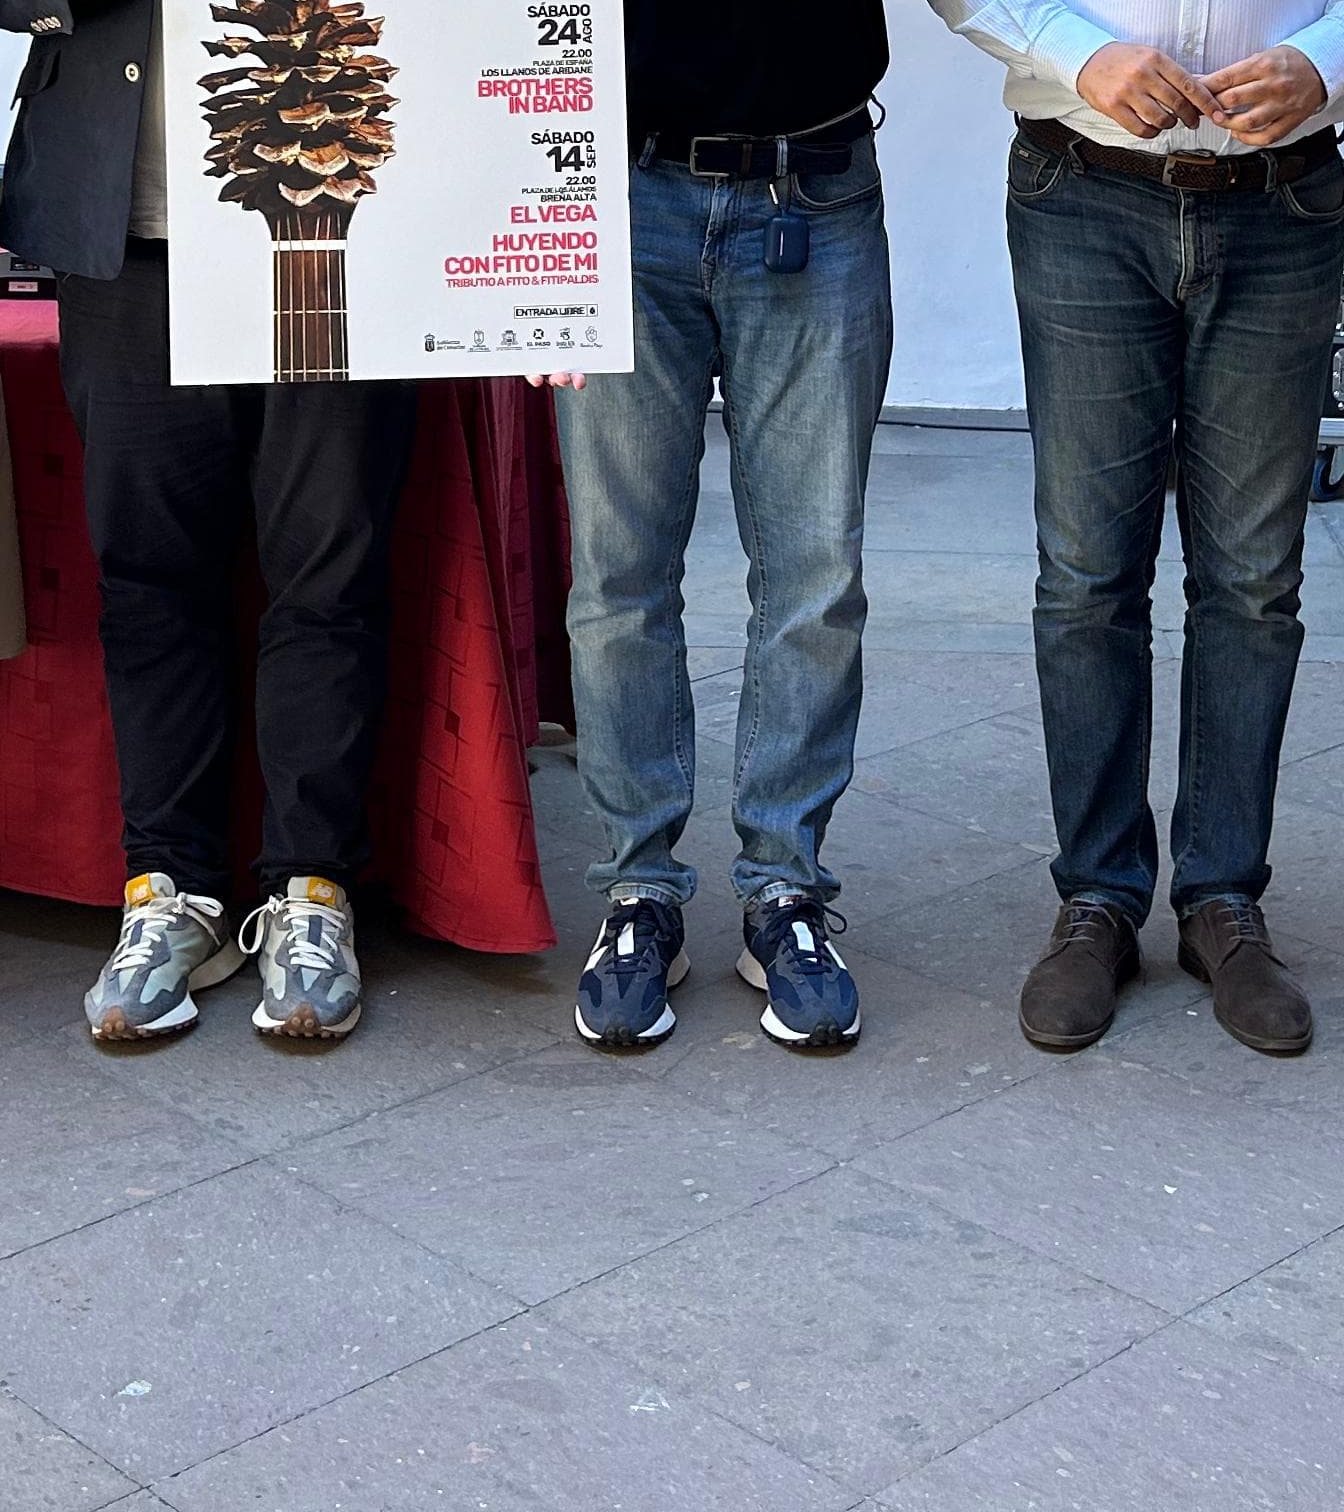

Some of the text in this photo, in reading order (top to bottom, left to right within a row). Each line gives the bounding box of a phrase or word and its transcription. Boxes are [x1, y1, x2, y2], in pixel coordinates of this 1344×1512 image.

[527, 1, 590, 18] SÁBADO
[538, 18, 581, 45] 24
[582, 18, 592, 43] AGO
[562, 49, 592, 58] 22.00
[481, 66, 592, 77] LOS LLANOS DE ARIDANE
[478, 77, 593, 97] BROTHERS
[509, 95, 593, 114] IN BAND
[531, 128, 595, 145] SÁBADO
[546, 145, 585, 172] 14
[586, 145, 596, 168] SEP
[566, 176, 596, 185] 22.00
[572, 193, 597, 201] ALTA
[511, 204, 597, 223] EL VEGA
[492, 231, 598, 252] HUYENDO
[444, 253, 598, 275] CON FITO DE MI
[496, 277, 505, 286] A
[506, 276, 530, 286] FITO
[531, 276, 539, 285] &
[541, 274, 599, 285] FITIPALDIS
[516, 308, 558, 316] ENTRADA
